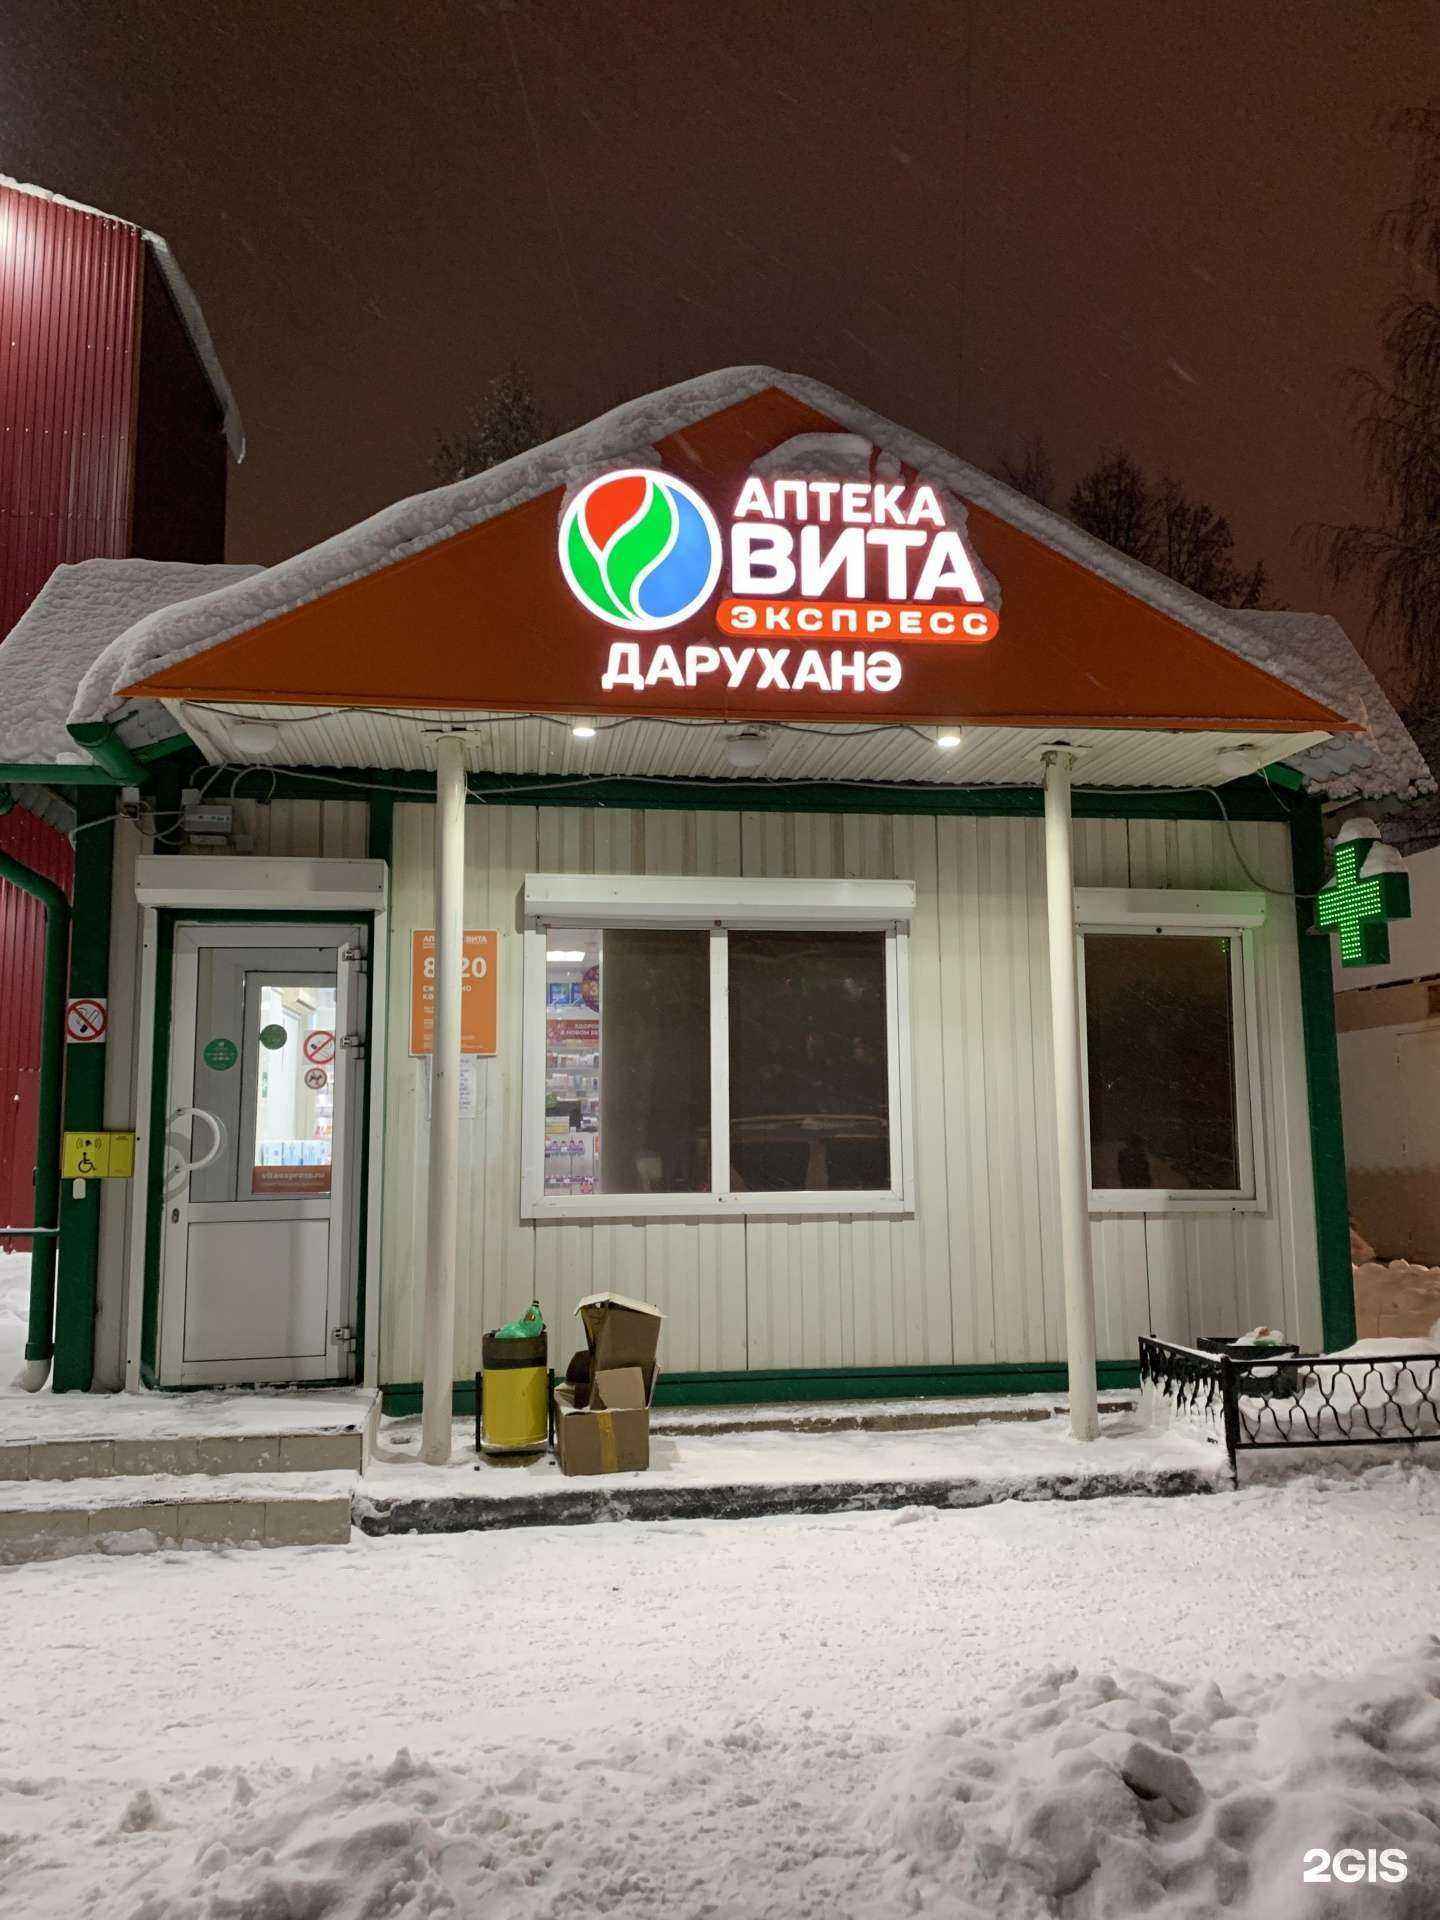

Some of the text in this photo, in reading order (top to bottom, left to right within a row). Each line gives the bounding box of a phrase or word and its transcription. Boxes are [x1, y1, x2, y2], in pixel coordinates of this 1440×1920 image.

[733, 477, 946, 526] АПТЕКА
[730, 523, 984, 603] ВИТА
[730, 607, 988, 636] ЭКСПРЕСС
[601, 642, 902, 692] ДАРУХАНӘ
